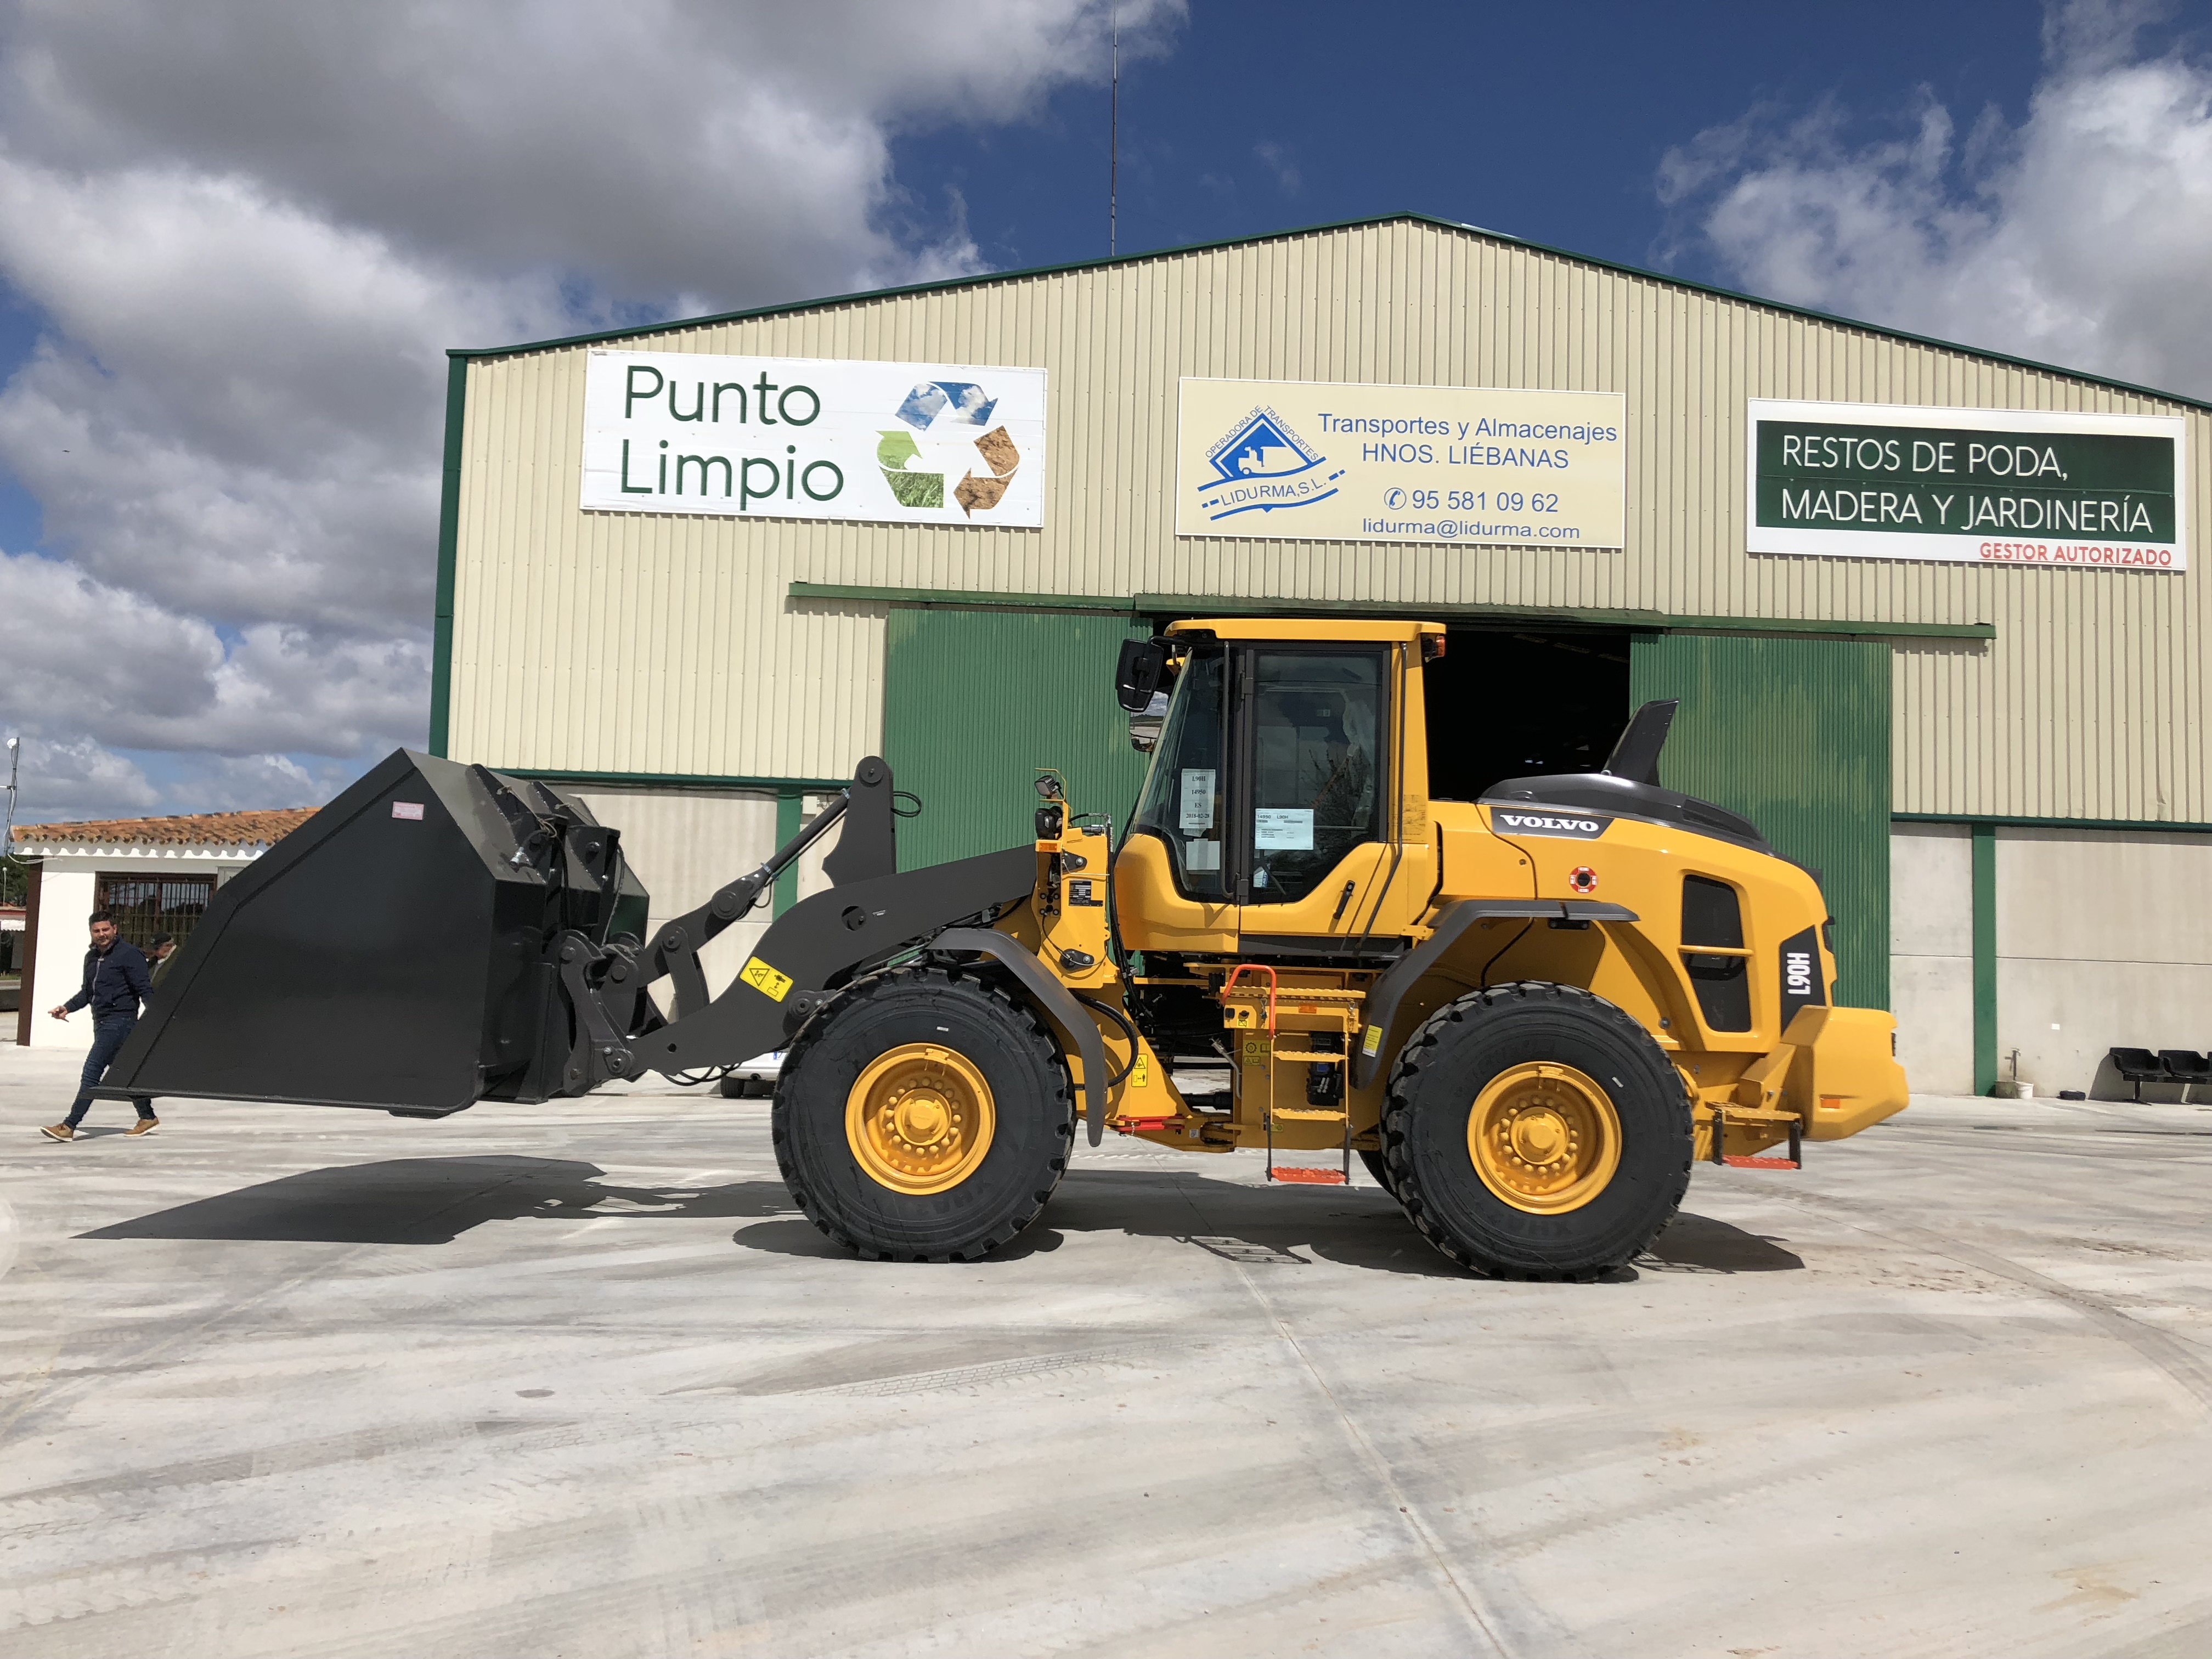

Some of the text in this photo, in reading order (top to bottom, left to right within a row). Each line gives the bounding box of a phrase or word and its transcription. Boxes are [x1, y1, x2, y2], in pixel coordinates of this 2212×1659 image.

[624, 365, 821, 426] Punto
[1205, 404, 1319, 461] OPERADORA DE TRANSPORTES
[1317, 413, 1617, 445] Transportes y Almacenajes
[1363, 442, 1569, 469] HNOS. LIÉBANAS
[1782, 435, 2068, 481] RESTOS DE PODA,
[620, 439, 844, 511] Limpio
[1412, 489, 1559, 513] 95 581 09 62
[1782, 488, 2153, 533] MADERA Y JARDINERÍA
[1363, 517, 1580, 539] lidurma@lidurma.com
[1979, 541, 2172, 566] GESTOR AUTORIZADO
[1499, 814, 1599, 832] VOLVO
[1786, 952, 1811, 995] L90H
